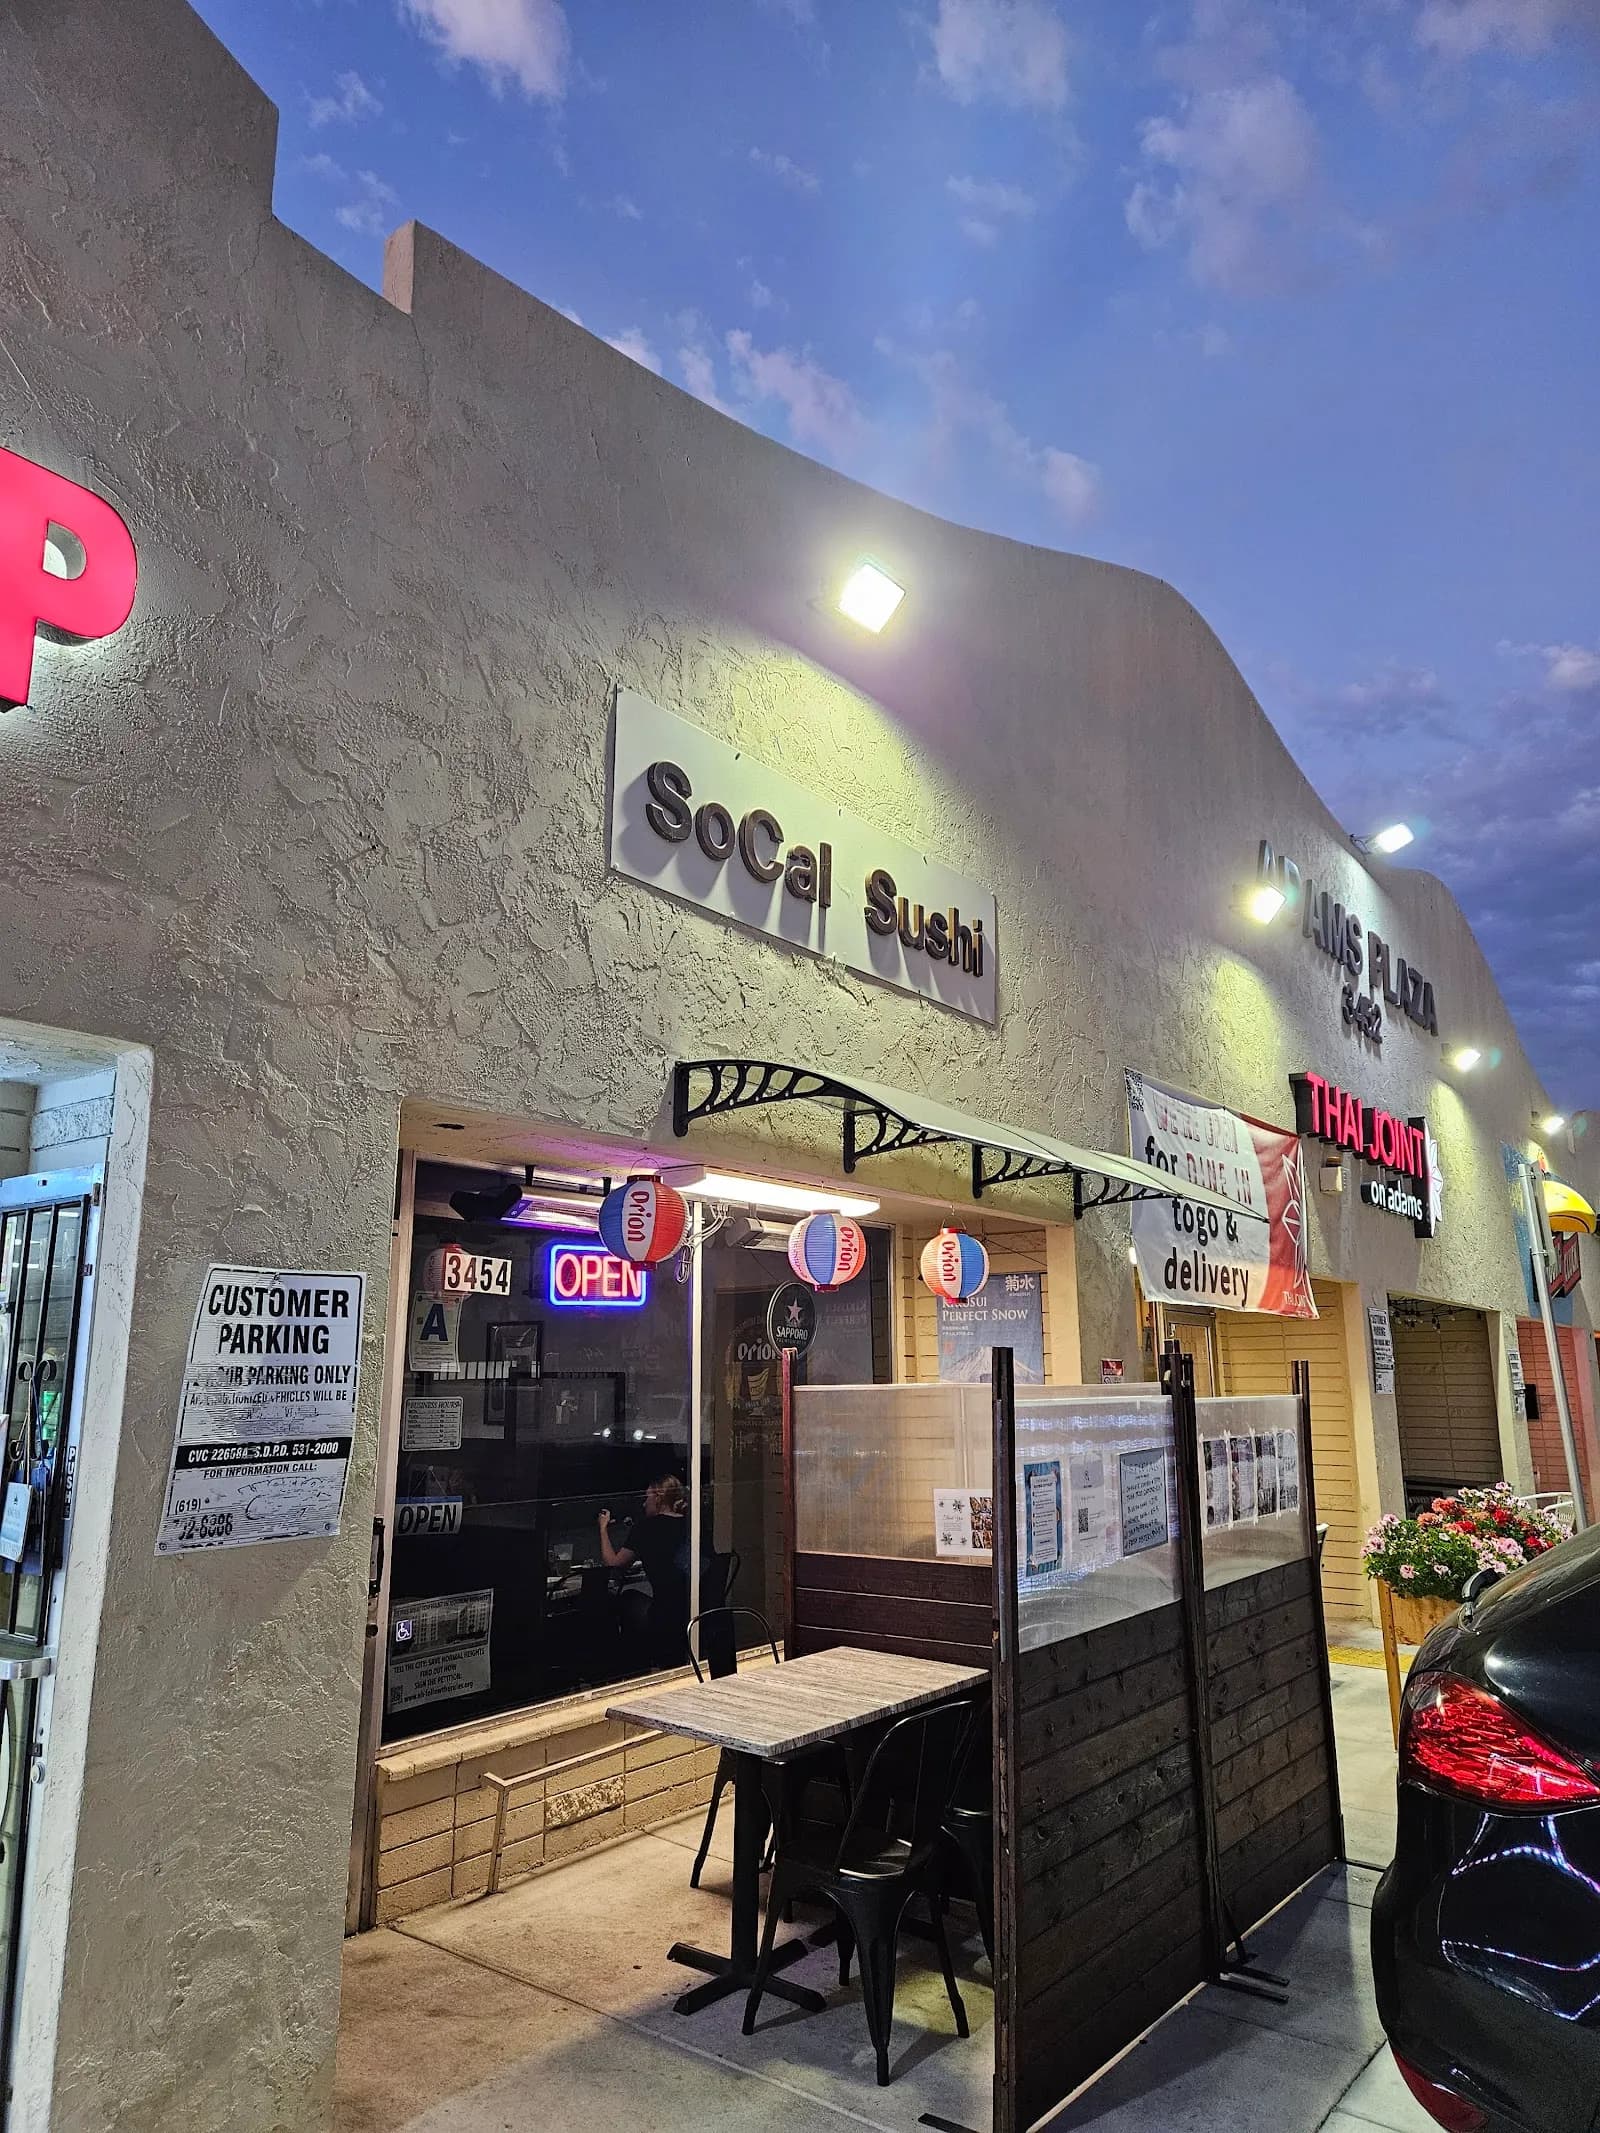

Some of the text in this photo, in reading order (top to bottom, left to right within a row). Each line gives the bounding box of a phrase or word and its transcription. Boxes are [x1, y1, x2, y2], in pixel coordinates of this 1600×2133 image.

[0, 447, 138, 706] P
[645, 760, 983, 977] SoCal Sushi
[1257, 840, 1439, 1036] ADAMS PLAZA
[1306, 1070, 1425, 1179] THAI JOINT
[1145, 1135, 1252, 1205] for DINE IN
[1370, 1180, 1423, 1221] on adams
[1172, 1197, 1218, 1246] togo
[447, 1255, 508, 1293] 3454
[555, 1252, 642, 1298] OPEN
[1164, 1246, 1249, 1307] delivery
[208, 1284, 349, 1319] CUSTOMER
[942, 1309, 1028, 1321] PERFECT SNOW
[218, 1324, 330, 1355] PARKING
[420, 1303, 448, 1342] A
[776, 1326, 808, 1340] SAPPORO
[248, 1366, 309, 1386] PARKING
[314, 1365, 351, 1384] ONLY
[312, 1390, 333, 1402] WILL
[336, 1390, 347, 1401] BE
[188, 1449, 208, 1463] CVC
[292, 1442, 339, 1456] 531-2000
[204, 1462, 318, 1479] FOR INFORMATION CALL:
[175, 1497, 201, 1516] (619)
[397, 1503, 458, 1534] OPEN
